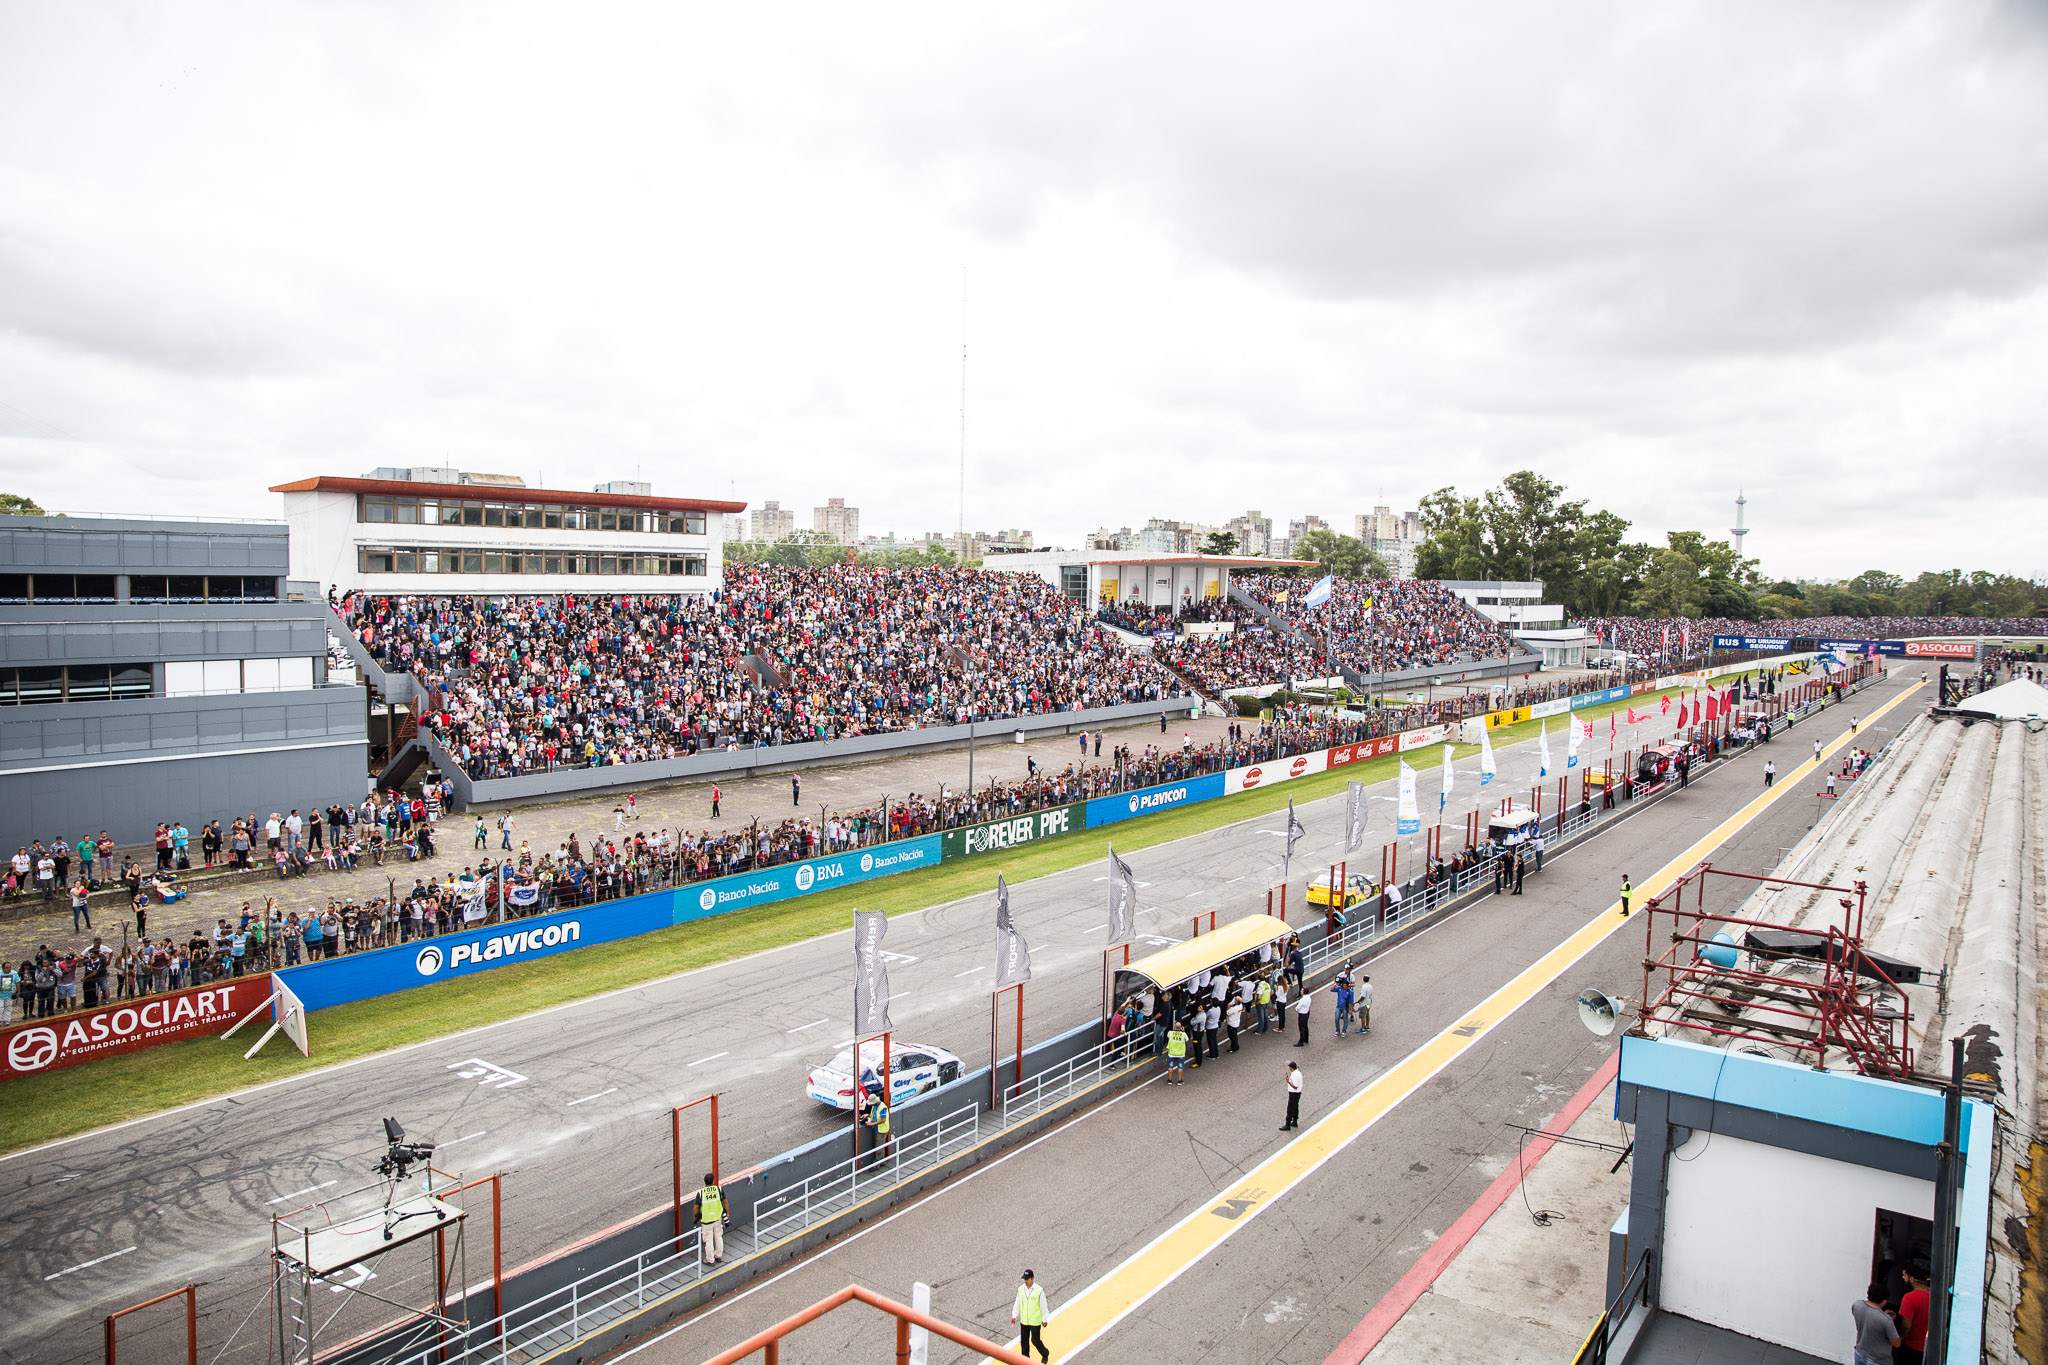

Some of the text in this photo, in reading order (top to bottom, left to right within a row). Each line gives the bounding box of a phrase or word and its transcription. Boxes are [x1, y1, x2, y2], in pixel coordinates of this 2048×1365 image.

[1718, 638, 1740, 646] RUS
[1920, 643, 1974, 653] ASOCIART
[965, 808, 1069, 854] FOREVER PIPE
[875, 849, 924, 868] Banco Nación
[817, 863, 844, 882] BNA
[718, 880, 780, 903] Banco Nación
[62, 986, 236, 1047] ASOCIART
[60, 1011, 237, 1058] AEGURADORA DE RIESGOS DEL TRABAJO
[705, 1193, 717, 1201] 144
